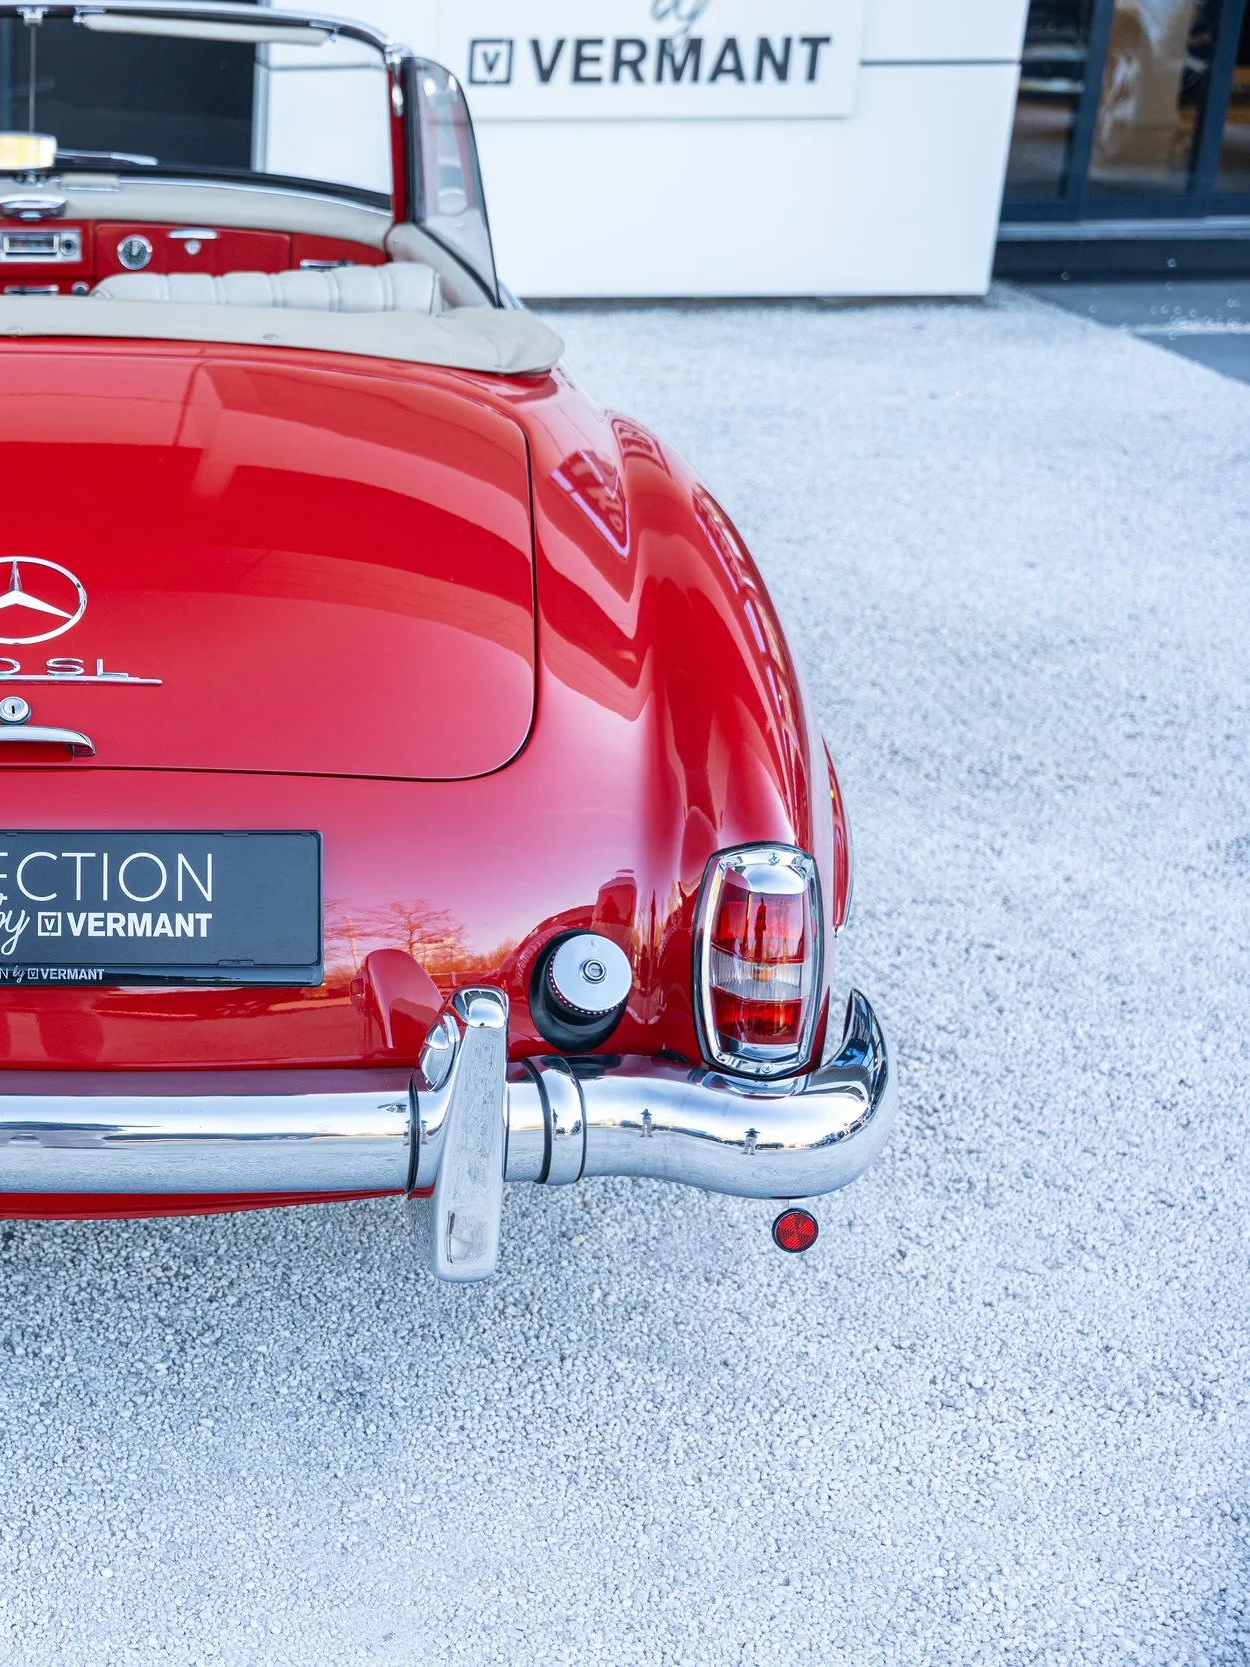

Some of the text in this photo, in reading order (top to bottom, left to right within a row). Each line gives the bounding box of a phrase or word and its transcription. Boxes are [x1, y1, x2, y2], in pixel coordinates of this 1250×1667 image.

[529, 36, 831, 85] VERMANT
[46, 658, 129, 678] SL
[67, 912, 213, 937] VERMANT
[12, 964, 25, 983] by
[41, 968, 105, 980] VERMANT
